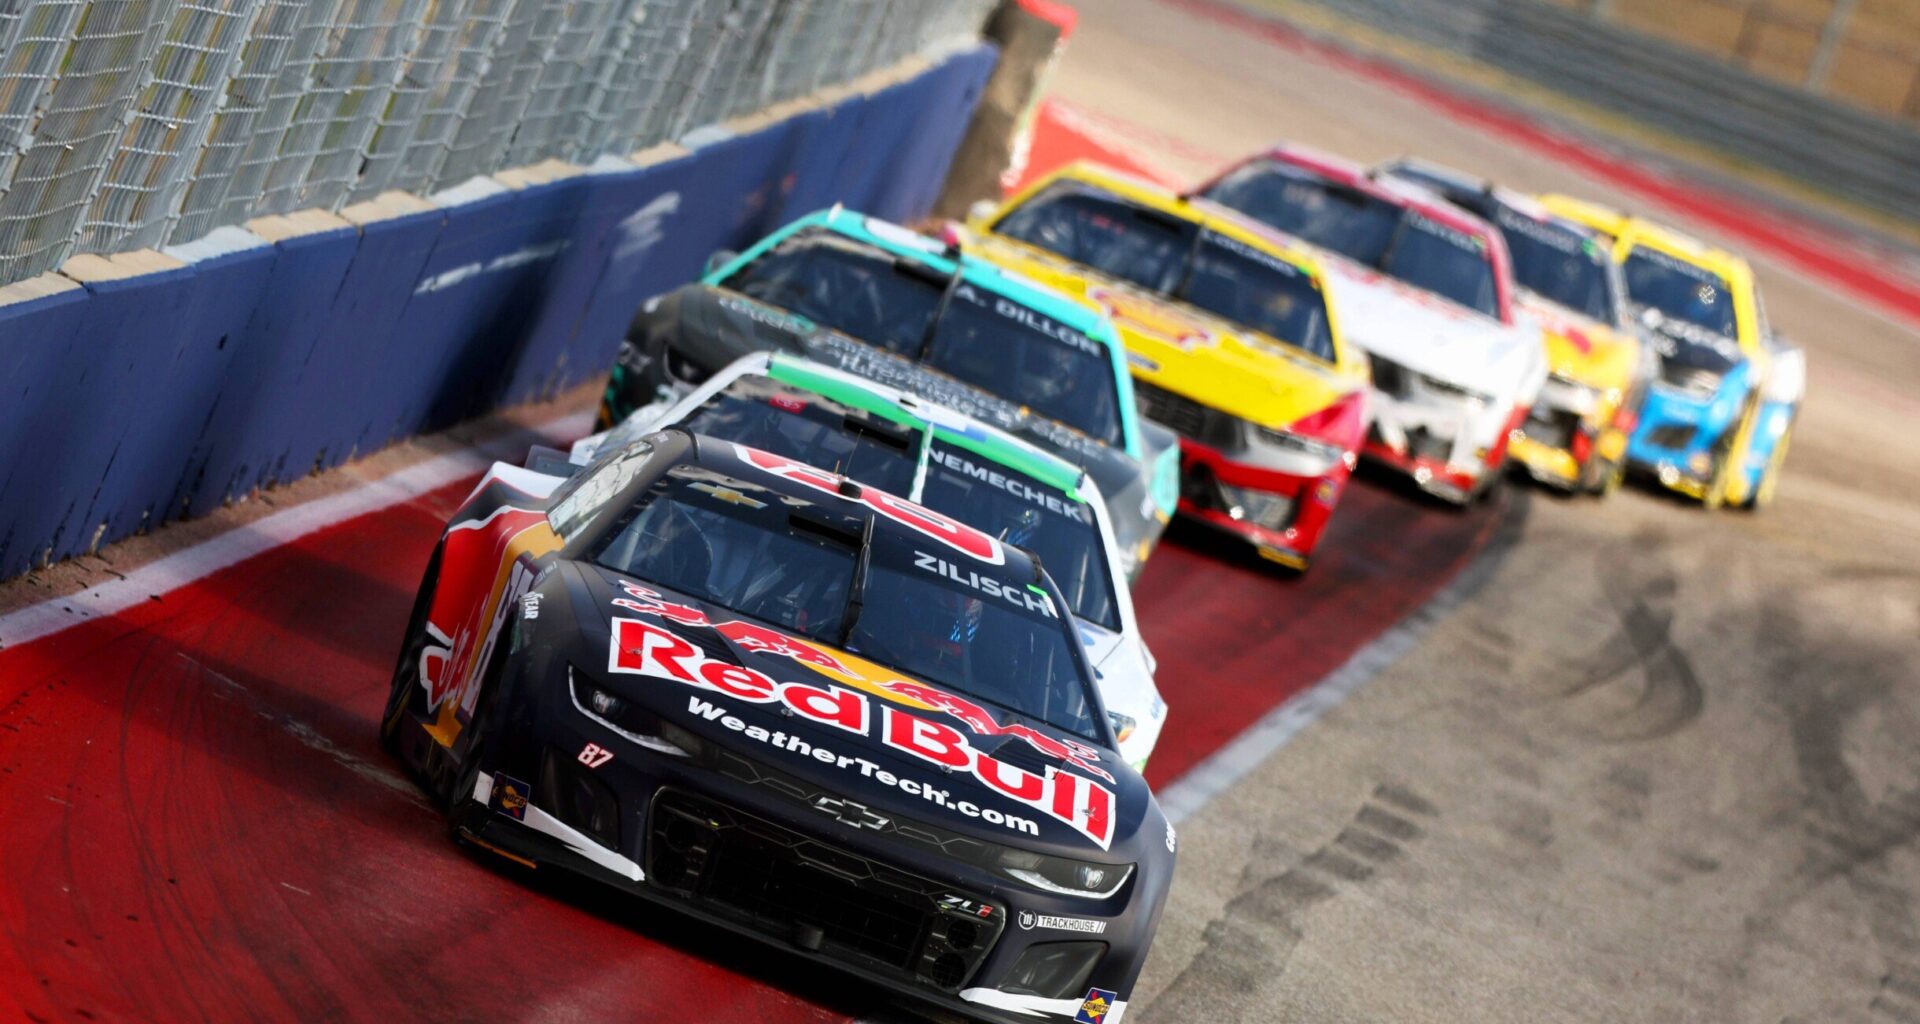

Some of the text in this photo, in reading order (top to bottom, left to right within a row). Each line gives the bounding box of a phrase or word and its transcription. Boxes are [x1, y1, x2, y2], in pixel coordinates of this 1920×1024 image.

[955, 284, 1100, 357] A. DILLON
[928, 447, 1083, 522] NEMECHEK
[914, 550, 1051, 618] ZILISCH
[578, 743, 615, 769] 87
[608, 616, 869, 737] Red
[880, 705, 1116, 852] Bull
[492, 785, 526, 808] SNOCO
[1040, 916, 1096, 933] TRACKHOUSE
